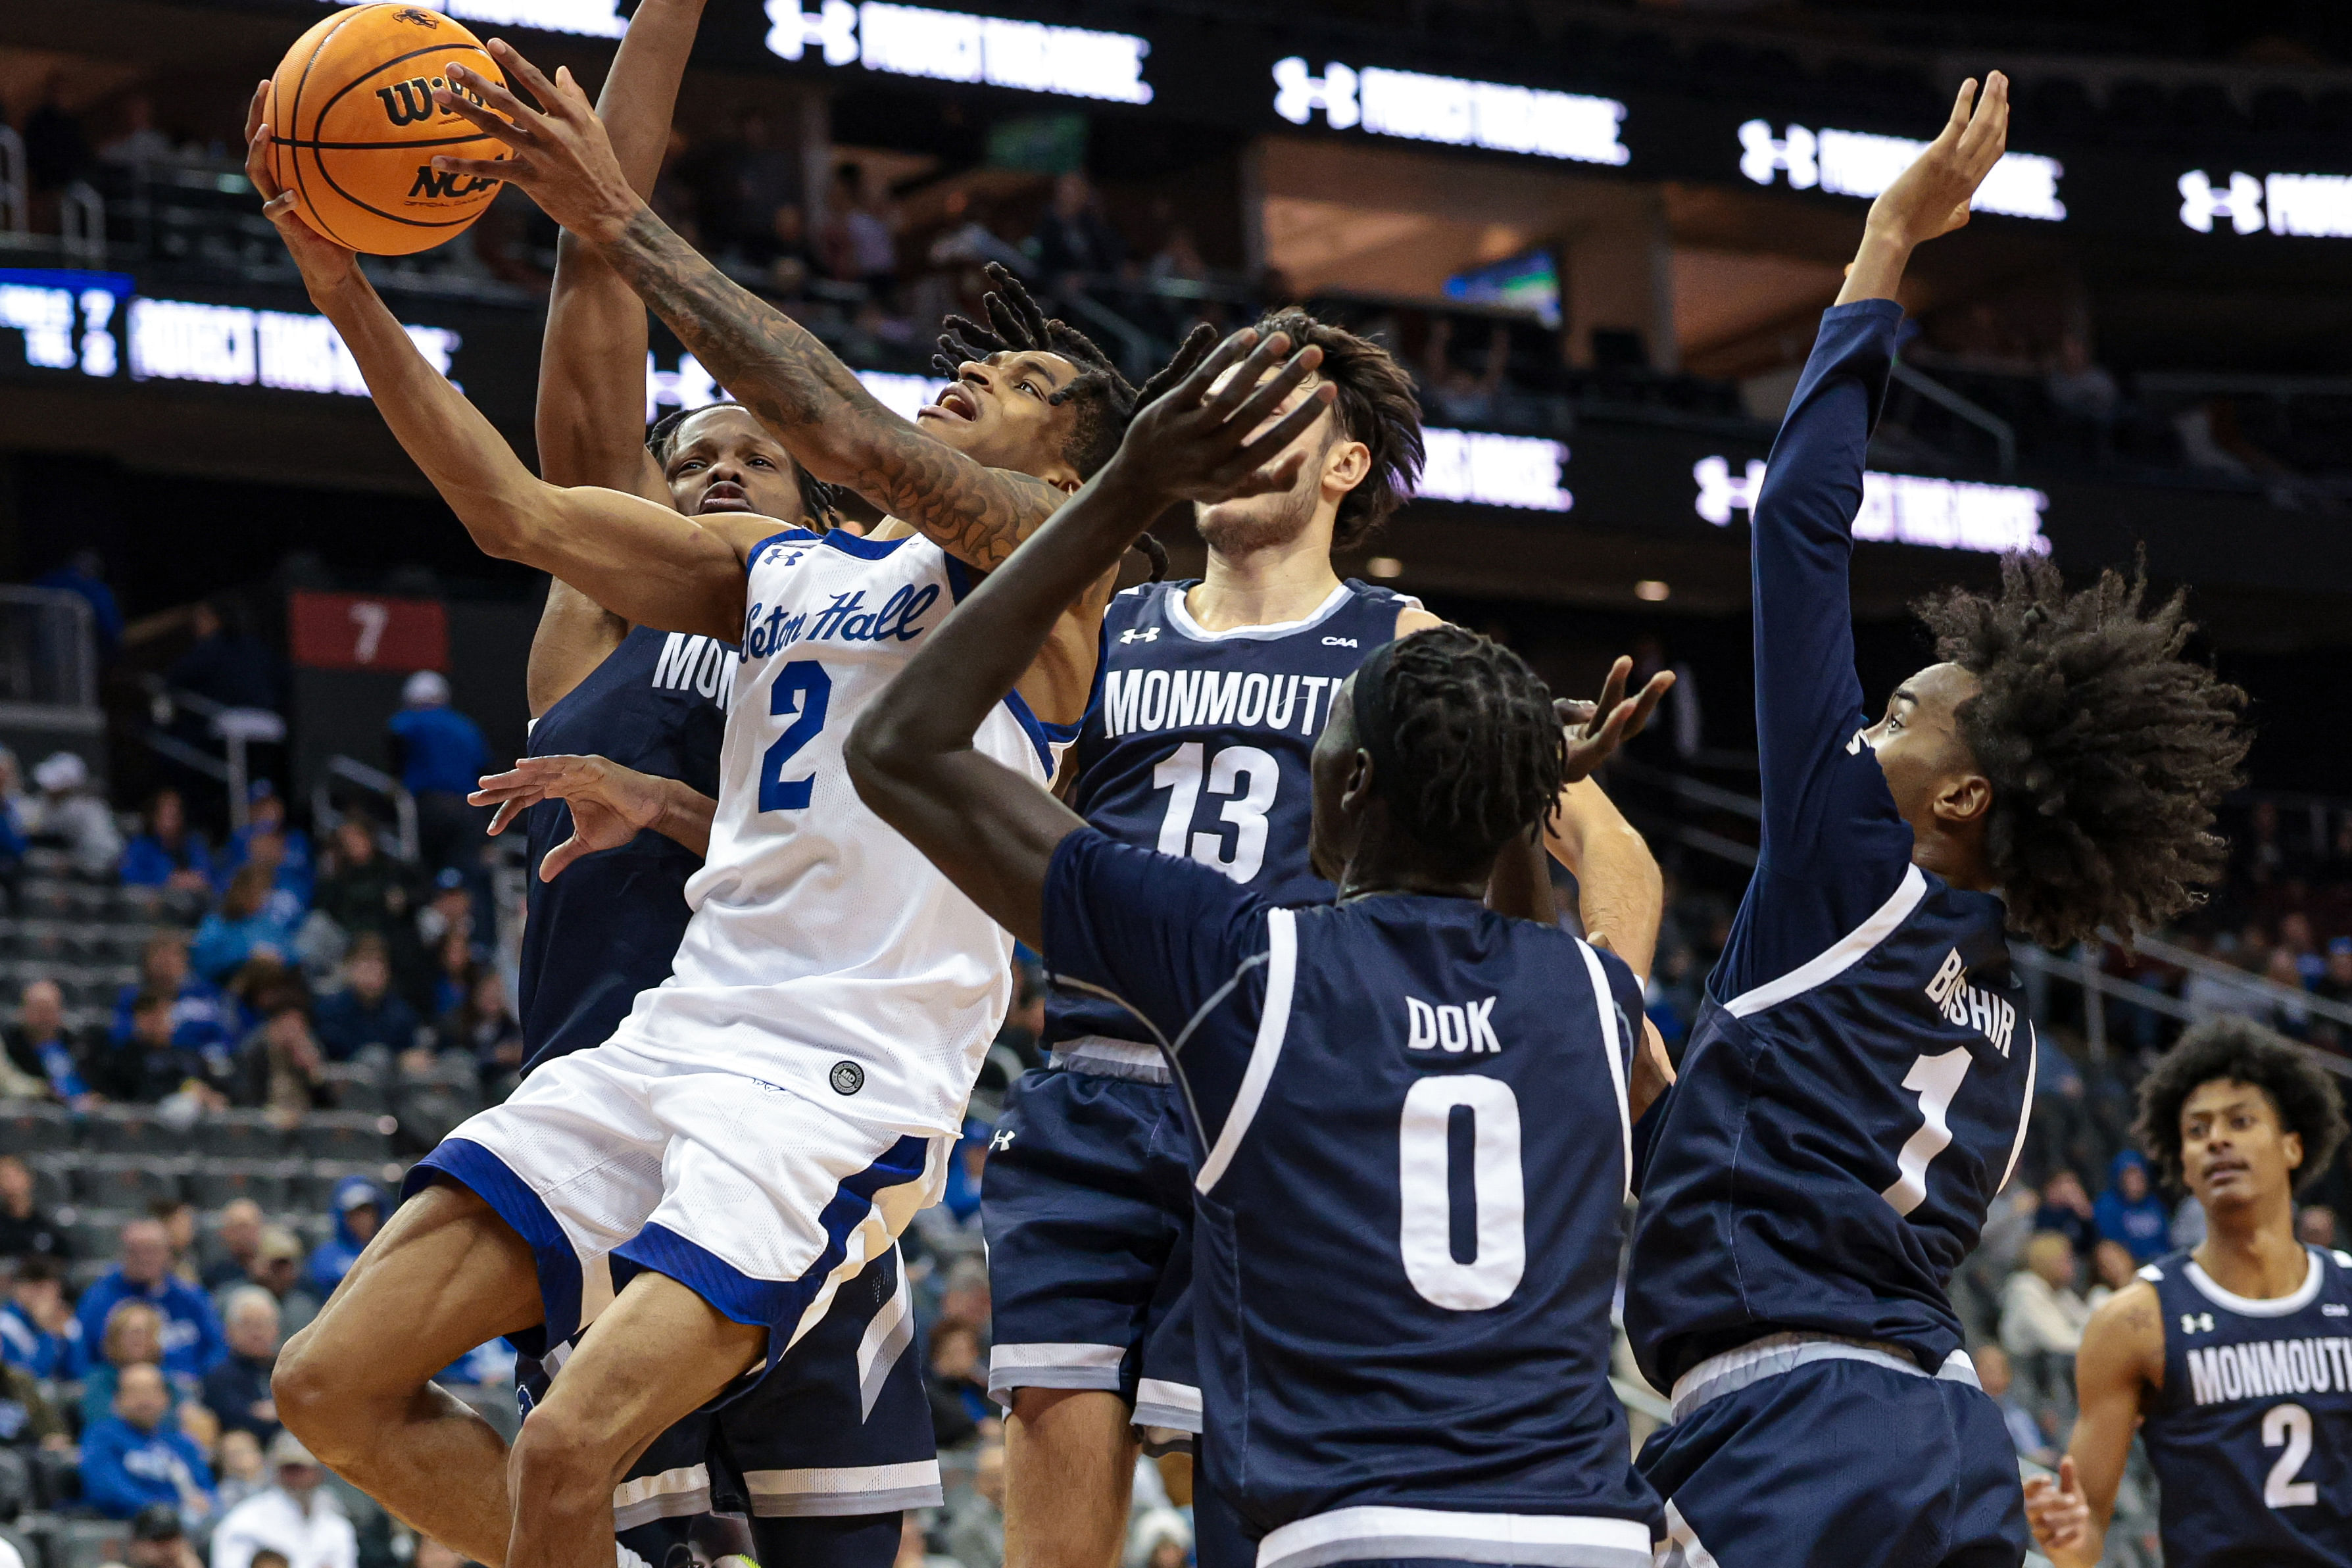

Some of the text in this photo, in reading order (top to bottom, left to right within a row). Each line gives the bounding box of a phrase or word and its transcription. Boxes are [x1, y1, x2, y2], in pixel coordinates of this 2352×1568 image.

[349, 601, 387, 664] 7
[739, 583, 940, 664] Seton Hall
[1321, 636, 1358, 649] CAA
[758, 660, 832, 813] 2
[1154, 742, 1279, 884] 13
[1405, 995, 1502, 1052] DOK
[1881, 1045, 1972, 1217] 1
[1400, 1074, 1526, 1311] 0
[2262, 1403, 2318, 1508] 2
